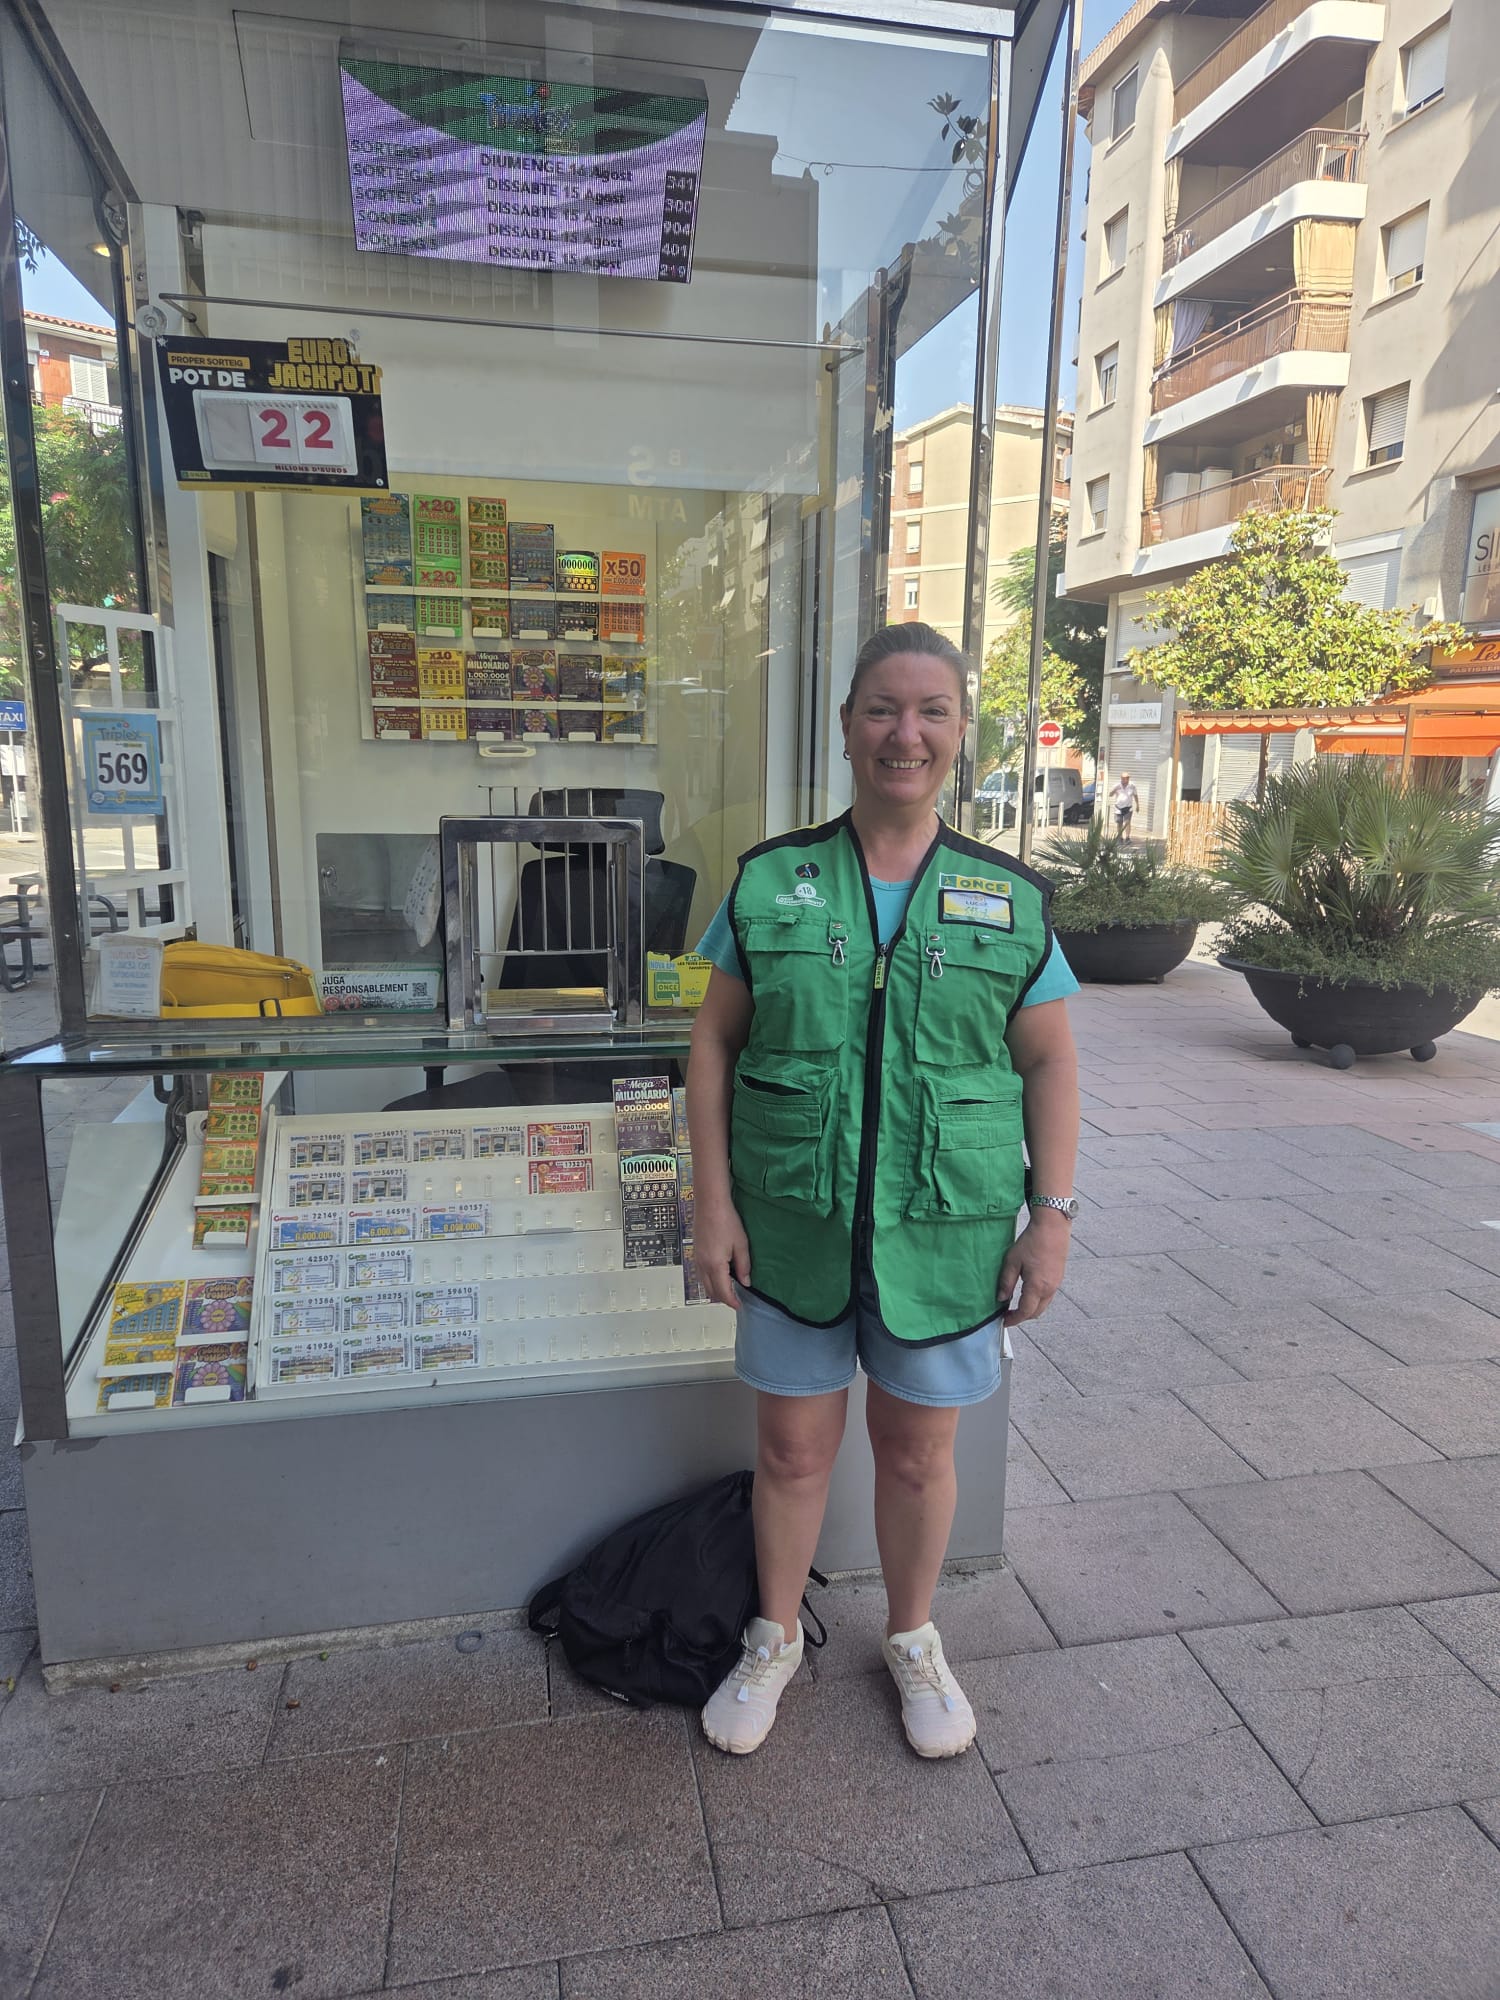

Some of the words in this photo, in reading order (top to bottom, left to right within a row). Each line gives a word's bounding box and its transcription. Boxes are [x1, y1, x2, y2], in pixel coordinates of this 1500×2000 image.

[481, 152, 565, 176] DIUMENGE
[590, 164, 633, 184] Agost
[487, 177, 558, 197] DISSABTE
[564, 184, 579, 199] 15
[584, 188, 625, 206] Agost
[487, 200, 558, 220] DISSABTE
[564, 207, 579, 222] 15
[583, 212, 625, 228] Agost
[488, 222, 557, 242] DISSABTE
[564, 229, 578, 243] 15
[583, 232, 624, 249] Agost
[661, 243, 688, 257] 401
[488, 244, 556, 263] DISSABTE
[563, 252, 578, 266] 15
[582, 255, 622, 271] Agost
[287, 338, 349, 363] EURO
[170, 355, 206, 366] PROPER
[206, 357, 244, 367] SORTEIG
[168, 367, 213, 385] POT
[216, 369, 247, 388] DE
[267, 362, 374, 392] JACKPOT
[259, 408, 334, 449] 22
[605, 560, 641, 577] x50
[467, 660, 510, 671] MILLONARIO
[0, 711, 24, 722] TAXI
[97, 726, 142, 742] Triplex
[1040, 730, 1060, 738] STOP
[98, 751, 149, 785] 569
[959, 879, 1007, 893] ONCE
[322, 976, 345, 985] JUGA
[322, 983, 409, 995] RESPONSABLEMENT
[658, 984, 679, 992] ONCE
[629, 1079, 655, 1090] Mega
[615, 1088, 669, 1102] MILLONARIO
[615, 1102, 670, 1113] 1.000.000€
[307, 1254, 334, 1263] 42507
